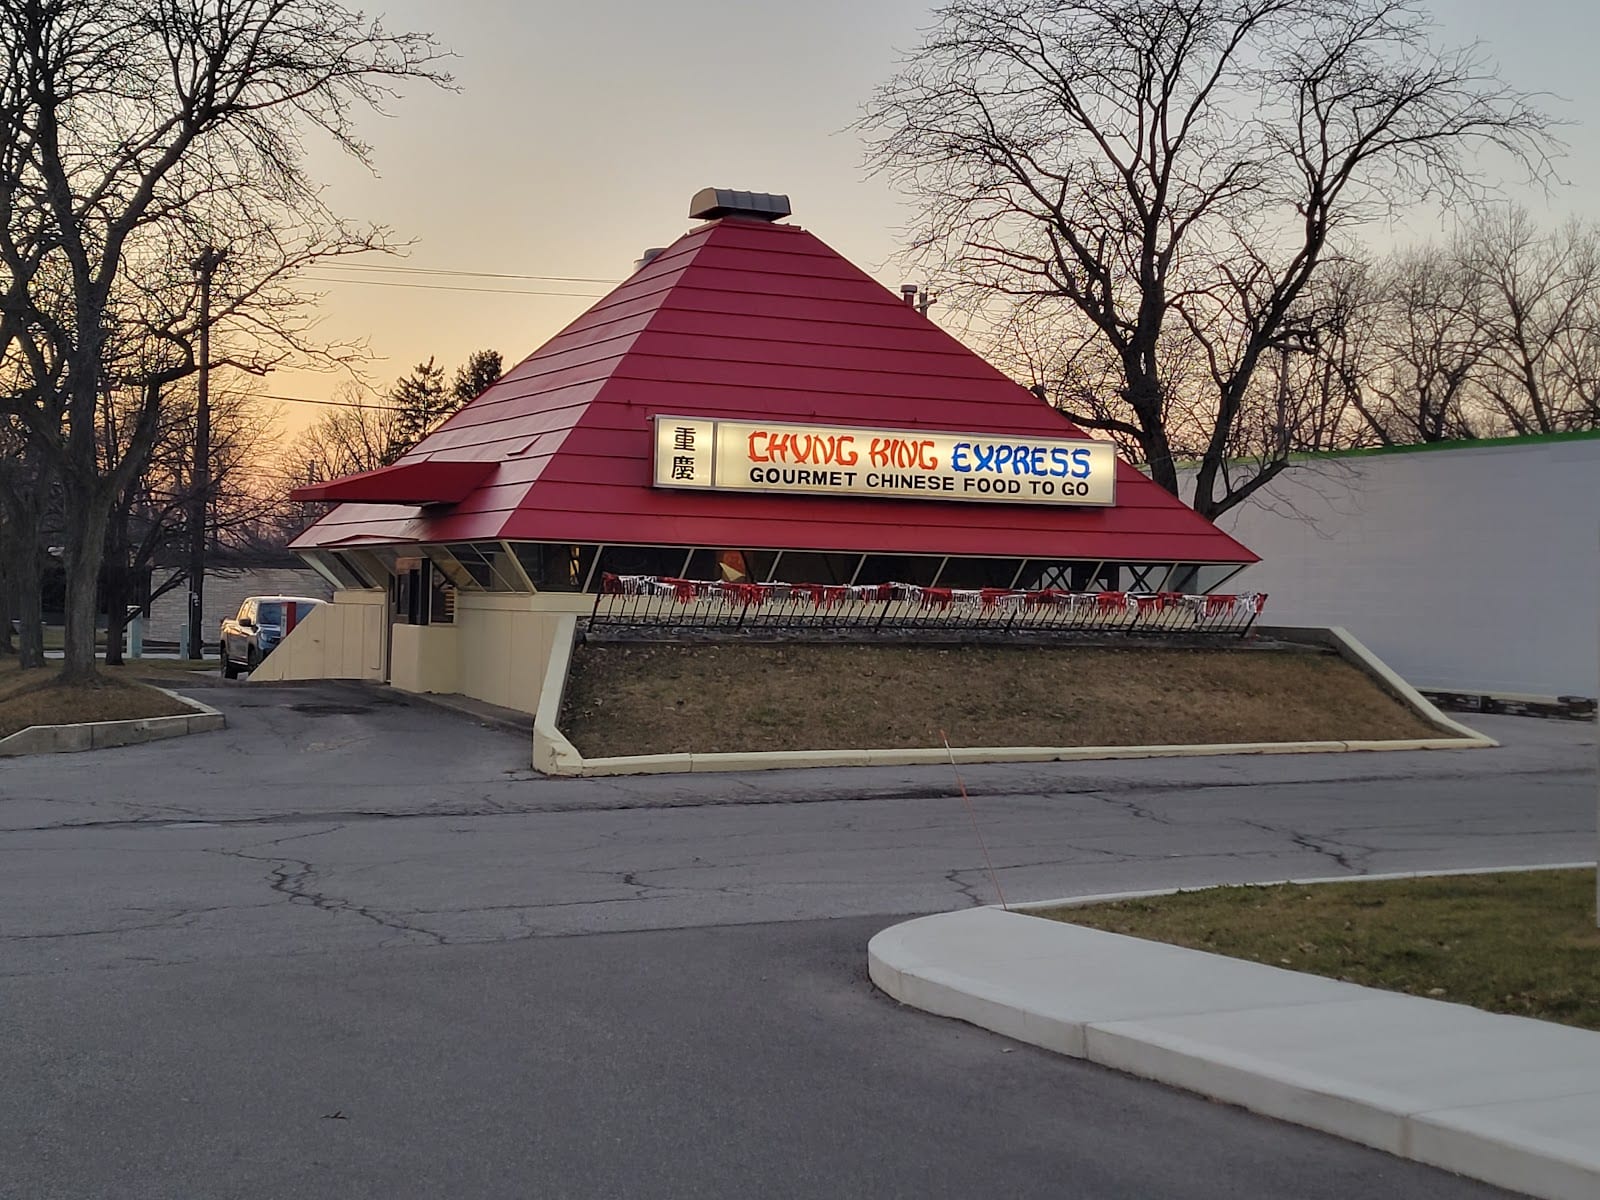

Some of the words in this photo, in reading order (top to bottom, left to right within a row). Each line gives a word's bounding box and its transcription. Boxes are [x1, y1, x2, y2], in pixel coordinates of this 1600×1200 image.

[671, 427, 697, 481] 重慶
[869, 437, 938, 471] KING
[951, 442, 1092, 479] EXPRESS
[749, 467, 857, 487] GOURMET
[866, 472, 955, 491] CHINESE
[964, 478, 1021, 494] FOOD
[1029, 480, 1055, 496] TO
[1061, 481, 1089, 497] GO
